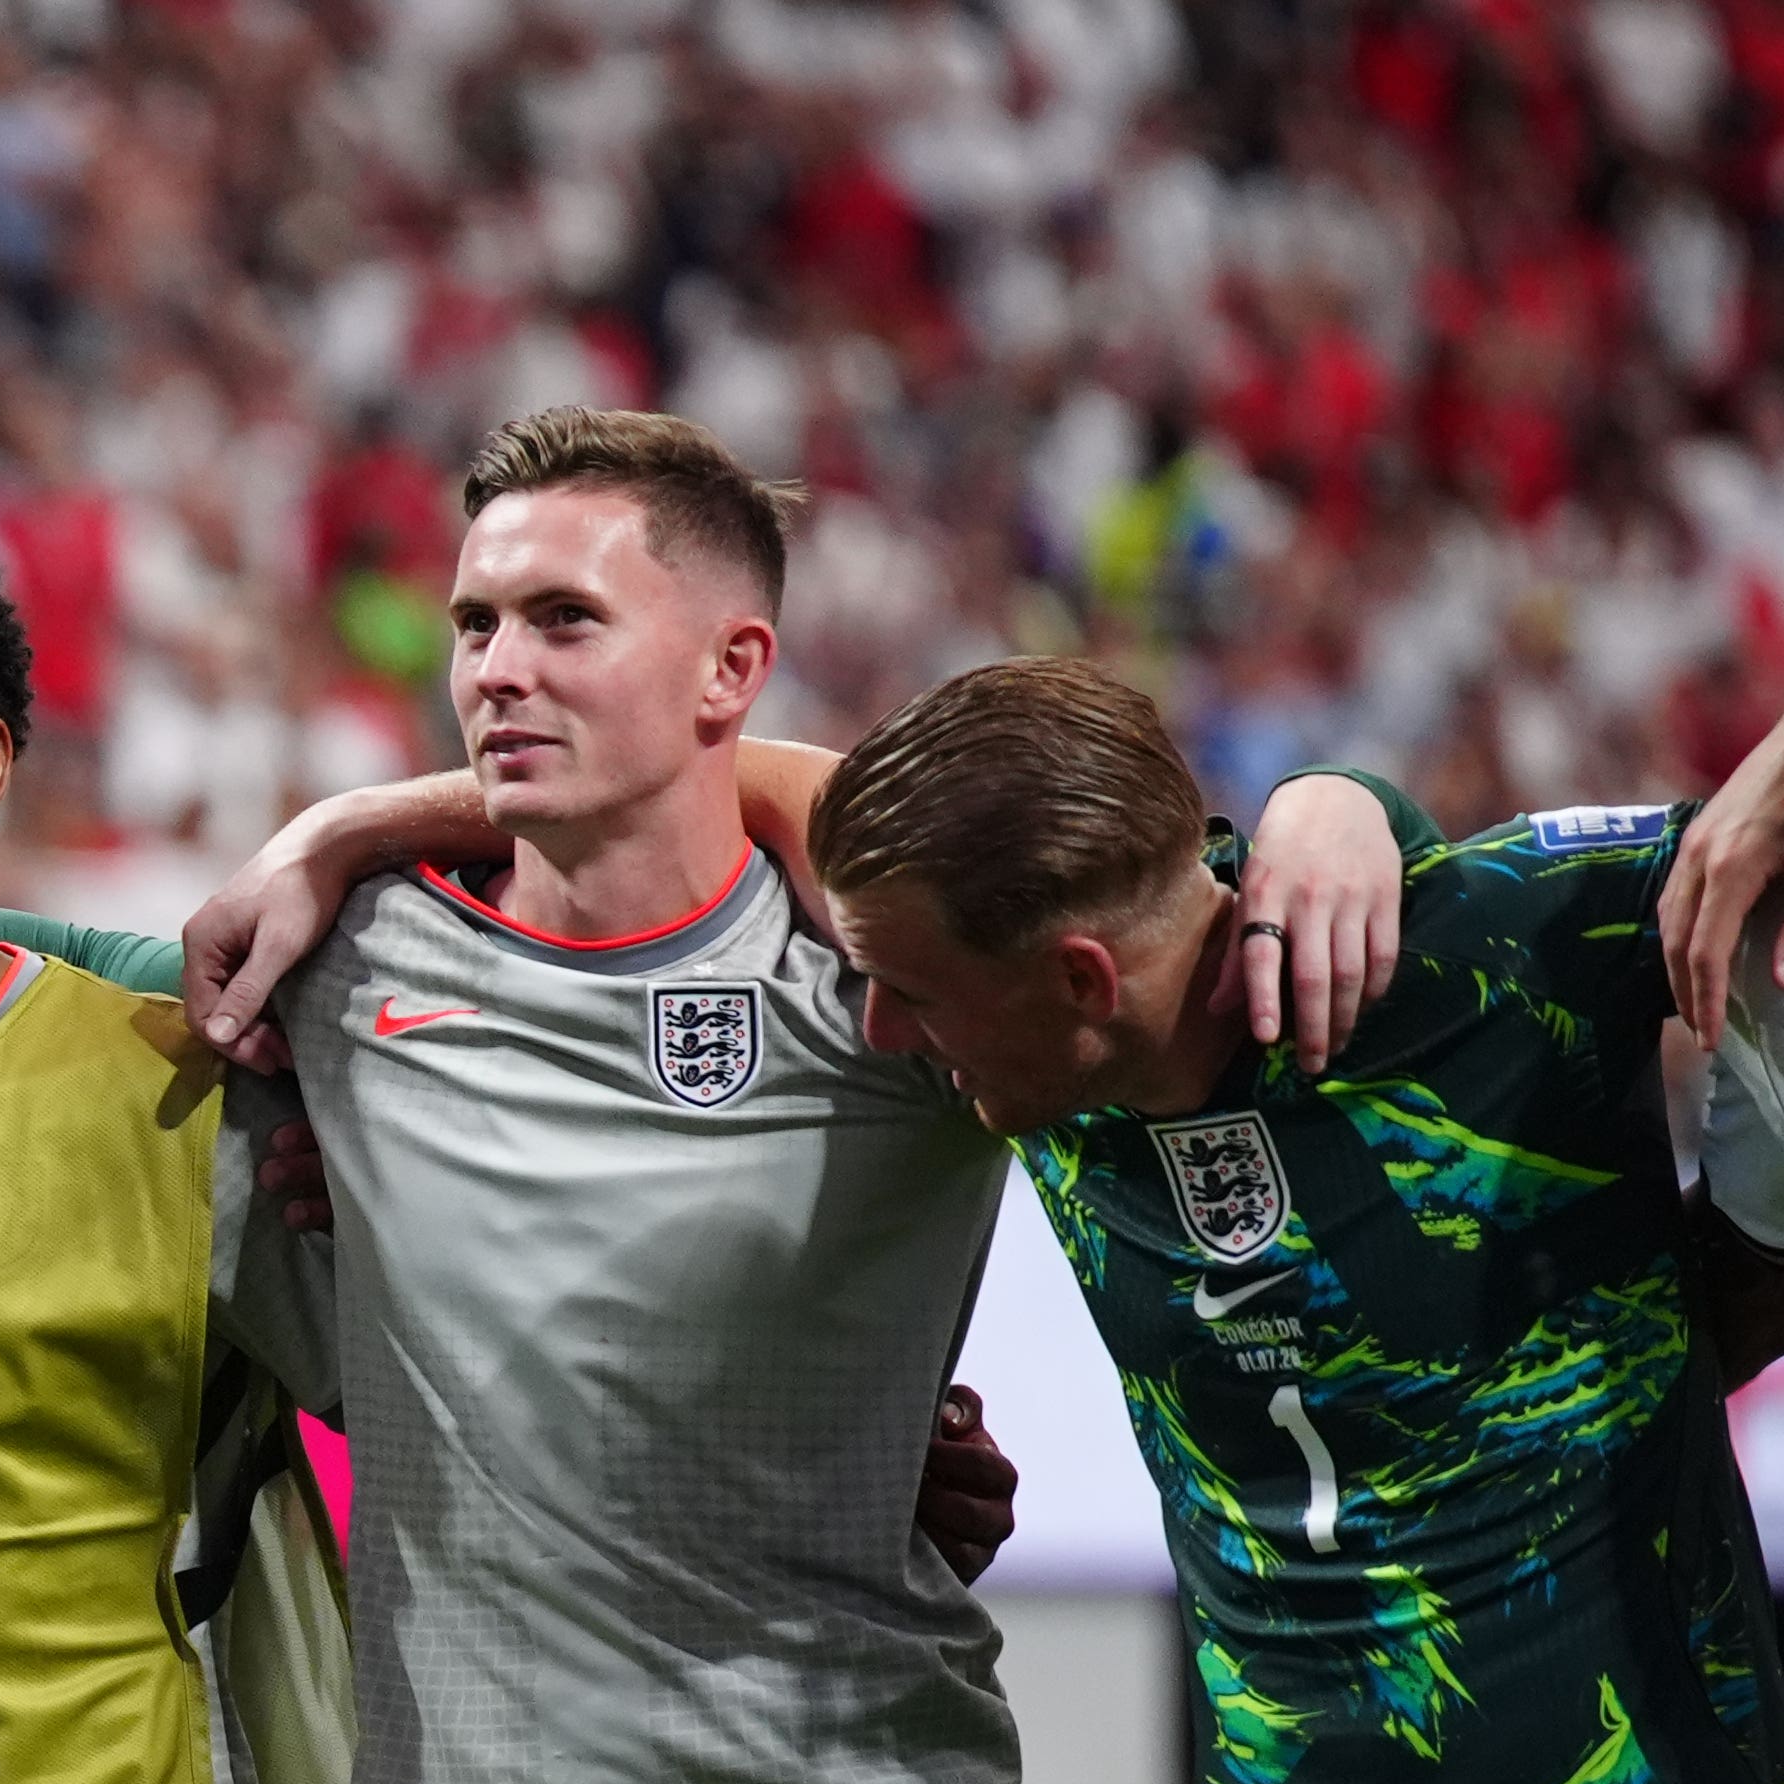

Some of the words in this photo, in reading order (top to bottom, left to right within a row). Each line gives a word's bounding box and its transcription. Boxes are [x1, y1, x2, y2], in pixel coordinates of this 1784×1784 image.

[1213, 1318, 1273, 1346] CONGO
[1275, 1316, 1305, 1340] DR
[1268, 1385, 1340, 1554] 1
